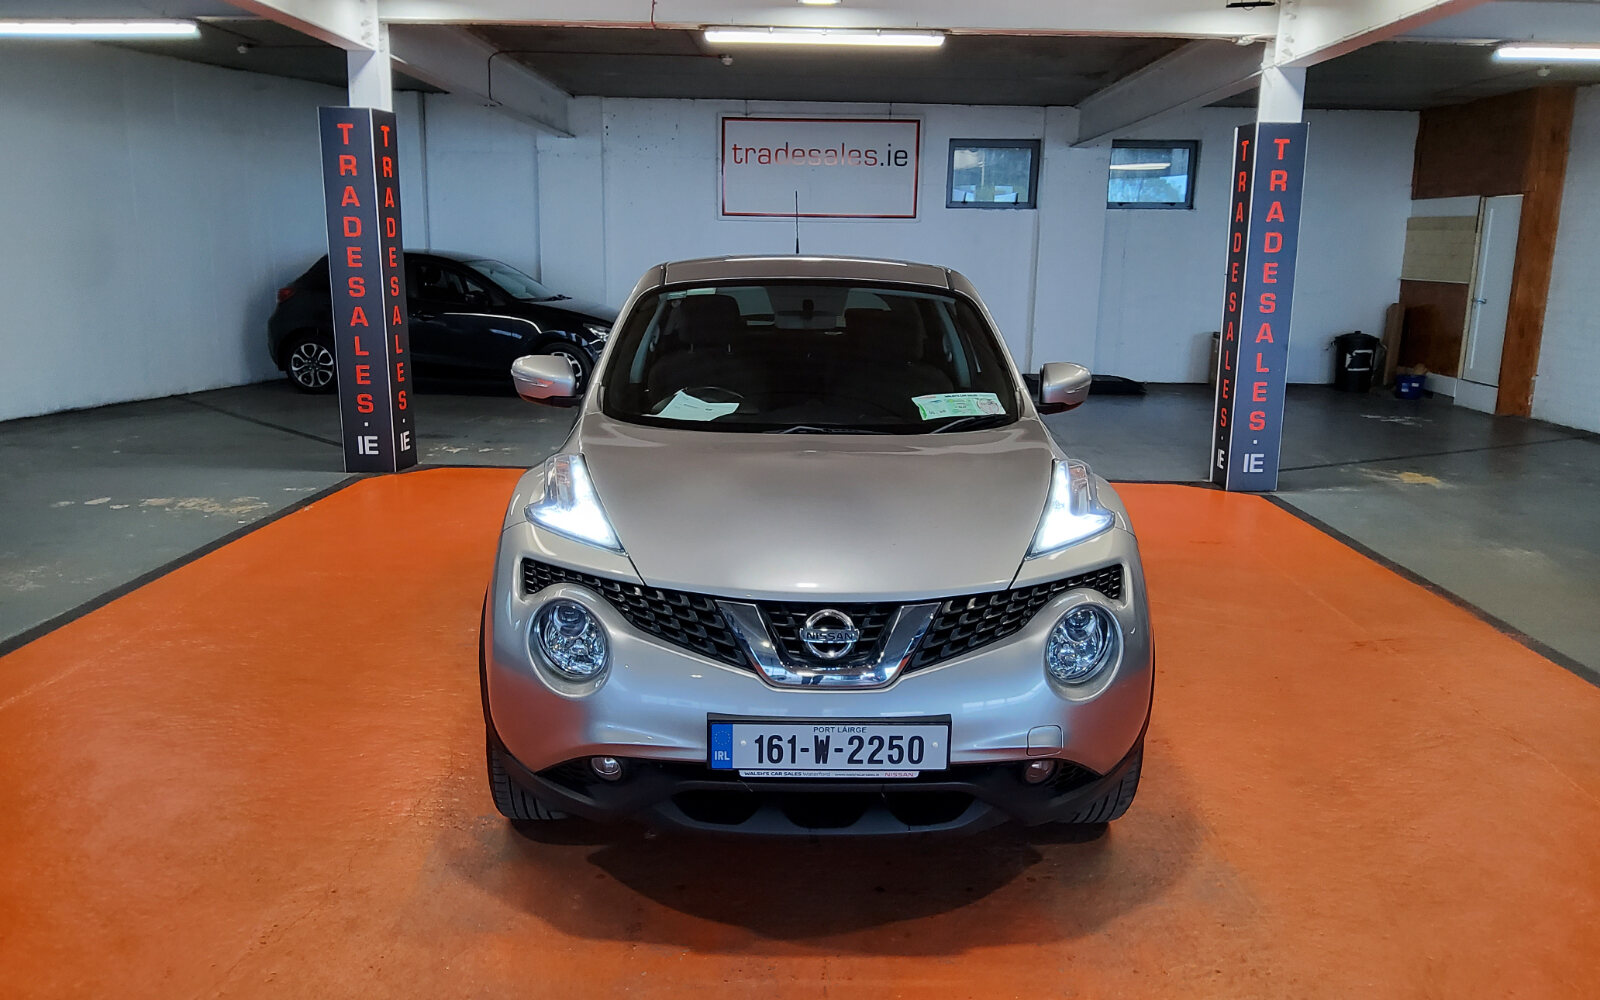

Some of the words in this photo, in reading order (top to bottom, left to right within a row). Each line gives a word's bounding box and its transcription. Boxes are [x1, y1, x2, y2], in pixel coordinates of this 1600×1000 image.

[731, 141, 908, 167] tradesales.ie
[805, 632, 854, 641] NISSAN
[714, 751, 731, 761] IRL
[754, 734, 925, 765] 161-W-2250
